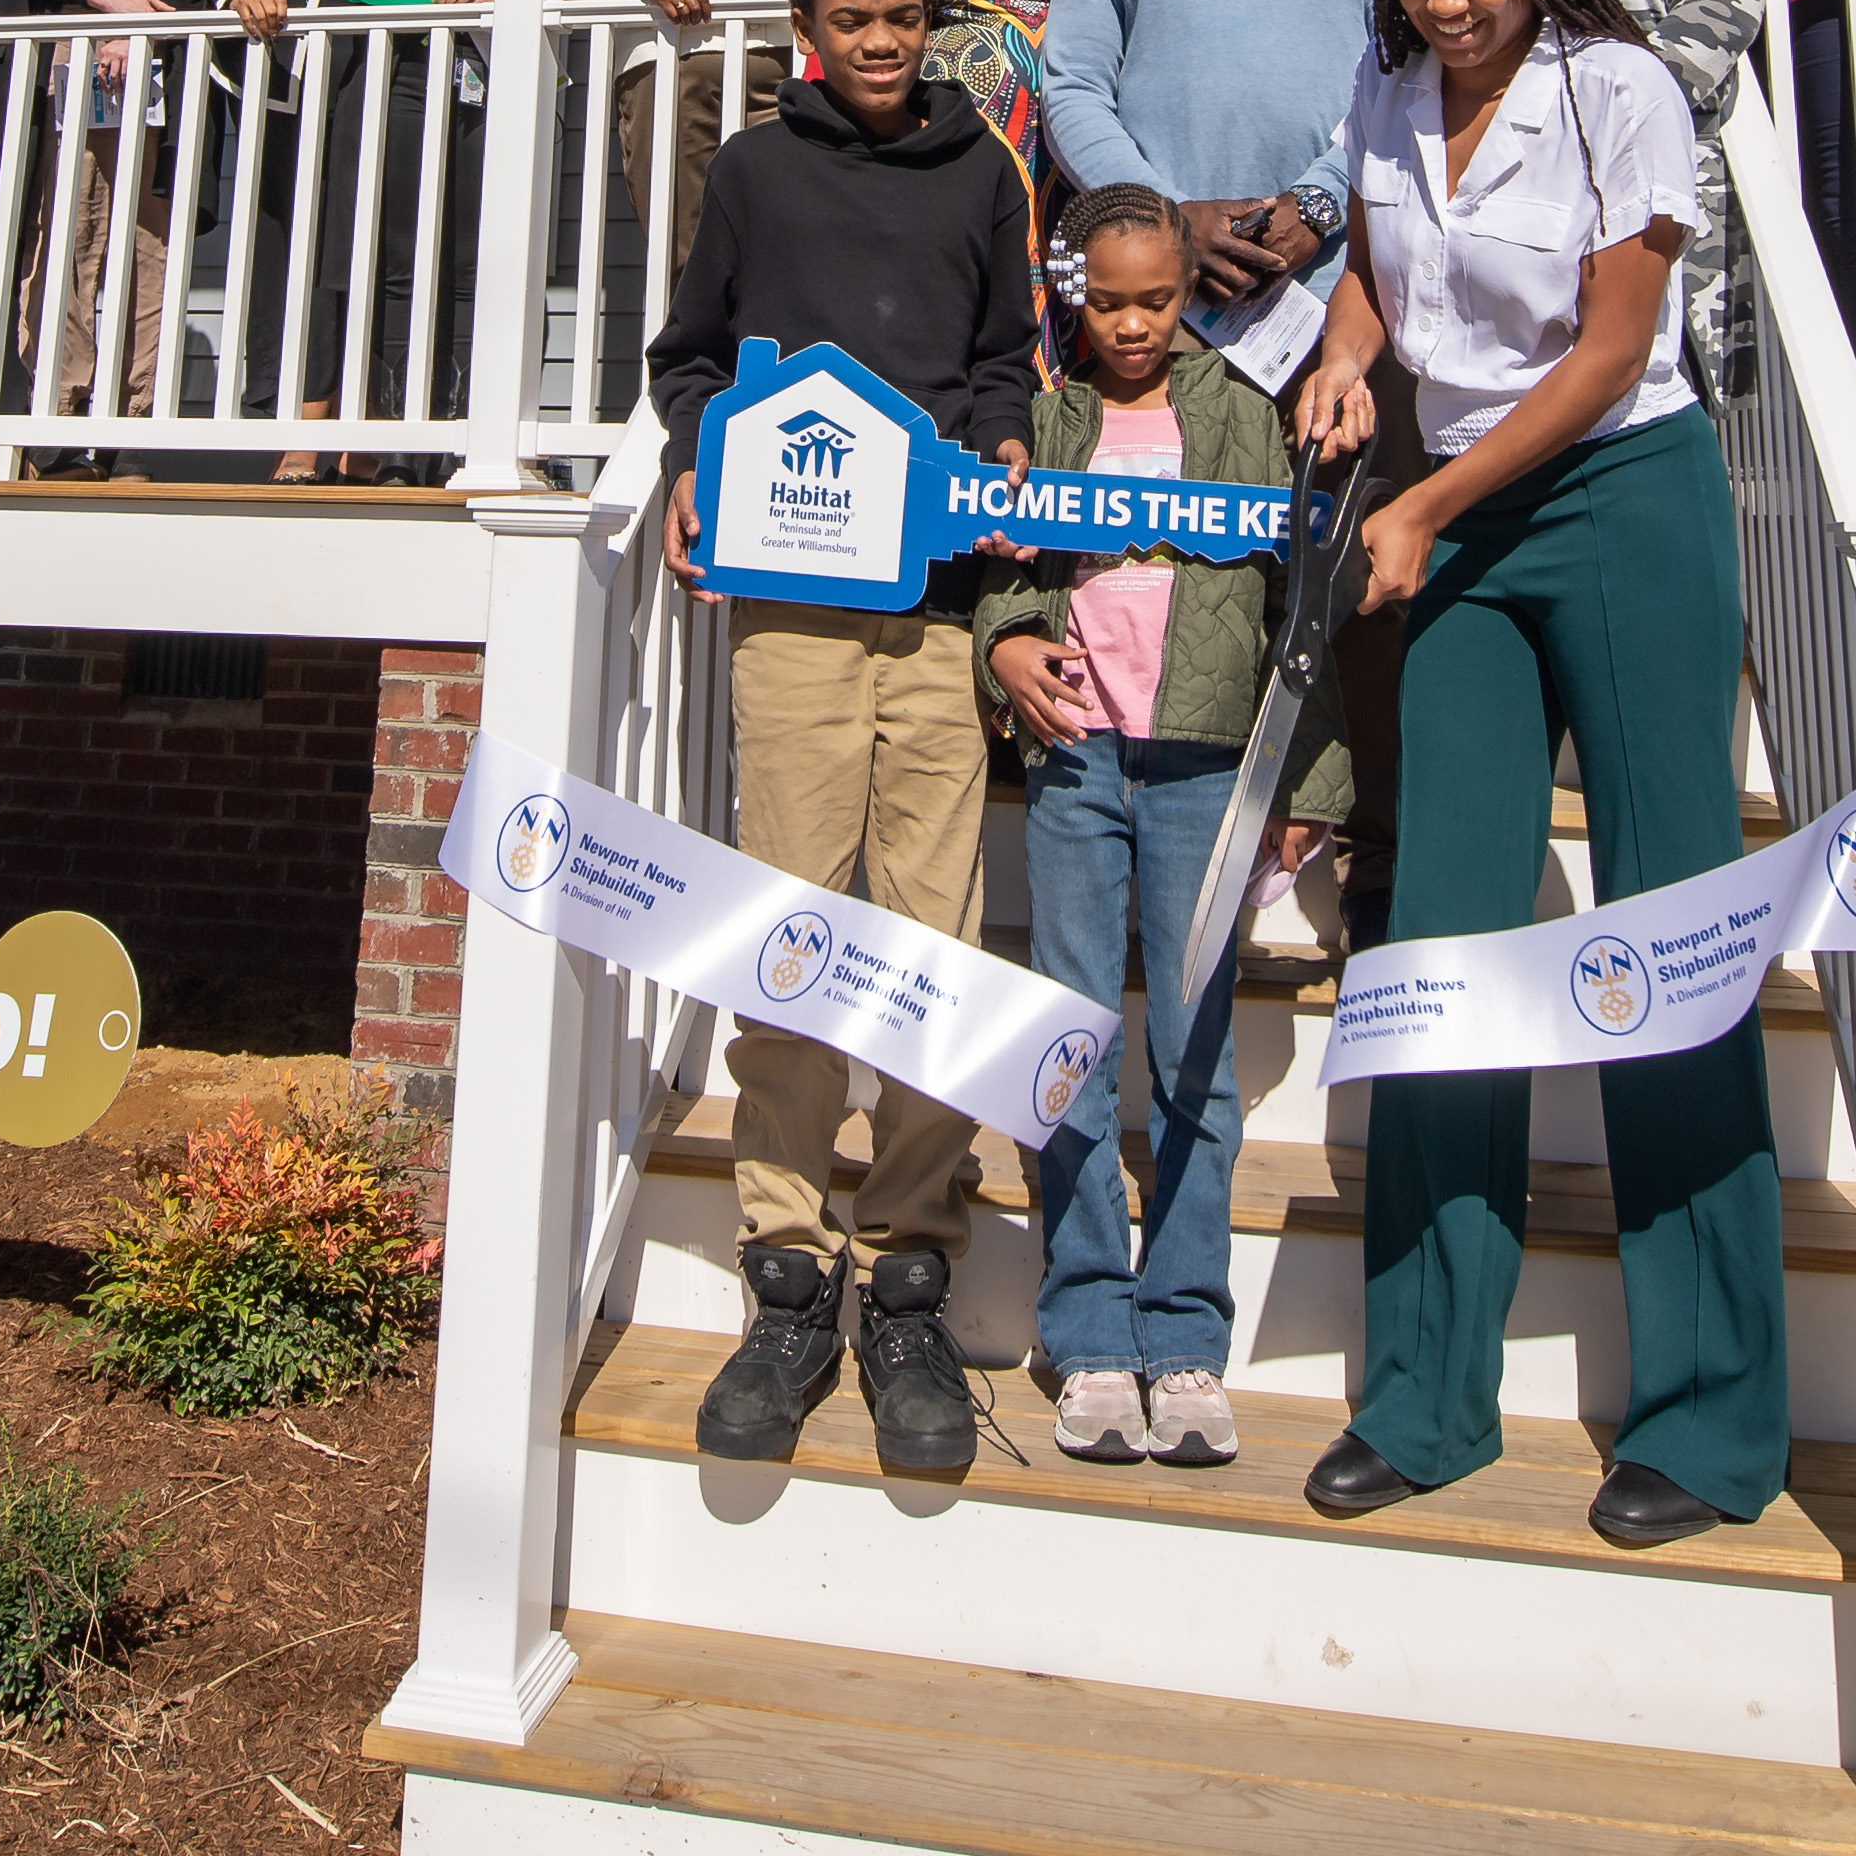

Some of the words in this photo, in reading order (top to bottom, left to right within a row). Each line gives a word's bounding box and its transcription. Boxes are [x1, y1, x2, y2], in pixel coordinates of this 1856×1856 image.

[769, 506, 789, 518] for
[770, 482, 852, 510] Habitat
[948, 476, 1083, 523] HOME
[1094, 488, 1133, 527] IS
[1141, 491, 1227, 535] THE
[762, 536, 795, 549] Greater
[798, 540, 857, 557] Williamsburg
[779, 522, 822, 536] Peninsula
[824, 526, 842, 538] and
[570, 857, 656, 910] Shipbuilding
[579, 833, 640, 873] Newport
[644, 862, 687, 894] News
[561, 882, 570, 895] A
[570, 885, 604, 909] Division
[605, 902, 615, 914] of
[616, 905, 632, 922] HII
[1650, 922, 1723, 959] Newport
[1728, 902, 1772, 933] News
[842, 942, 909, 982] Newport
[1658, 937, 1757, 983] Shipbuilding
[832, 964, 927, 1022] Shipbuilding
[1338, 982, 1408, 1010] Newport
[1416, 979, 1466, 993] News
[1666, 993, 1676, 1006] A
[1677, 982, 1720, 1003] Division
[1720, 973, 1732, 987] of
[1734, 965, 1747, 982] HII
[822, 988, 831, 1000] A
[833, 991, 866, 1011] Divisi
[887, 1013, 904, 1031] HII
[1338, 1000, 1444, 1029] Shipbuilding
[1340, 1034, 1350, 1046] A
[1351, 1028, 1394, 1043] Division
[1398, 1024, 1409, 1034] of
[1412, 1023, 1429, 1034] HII
